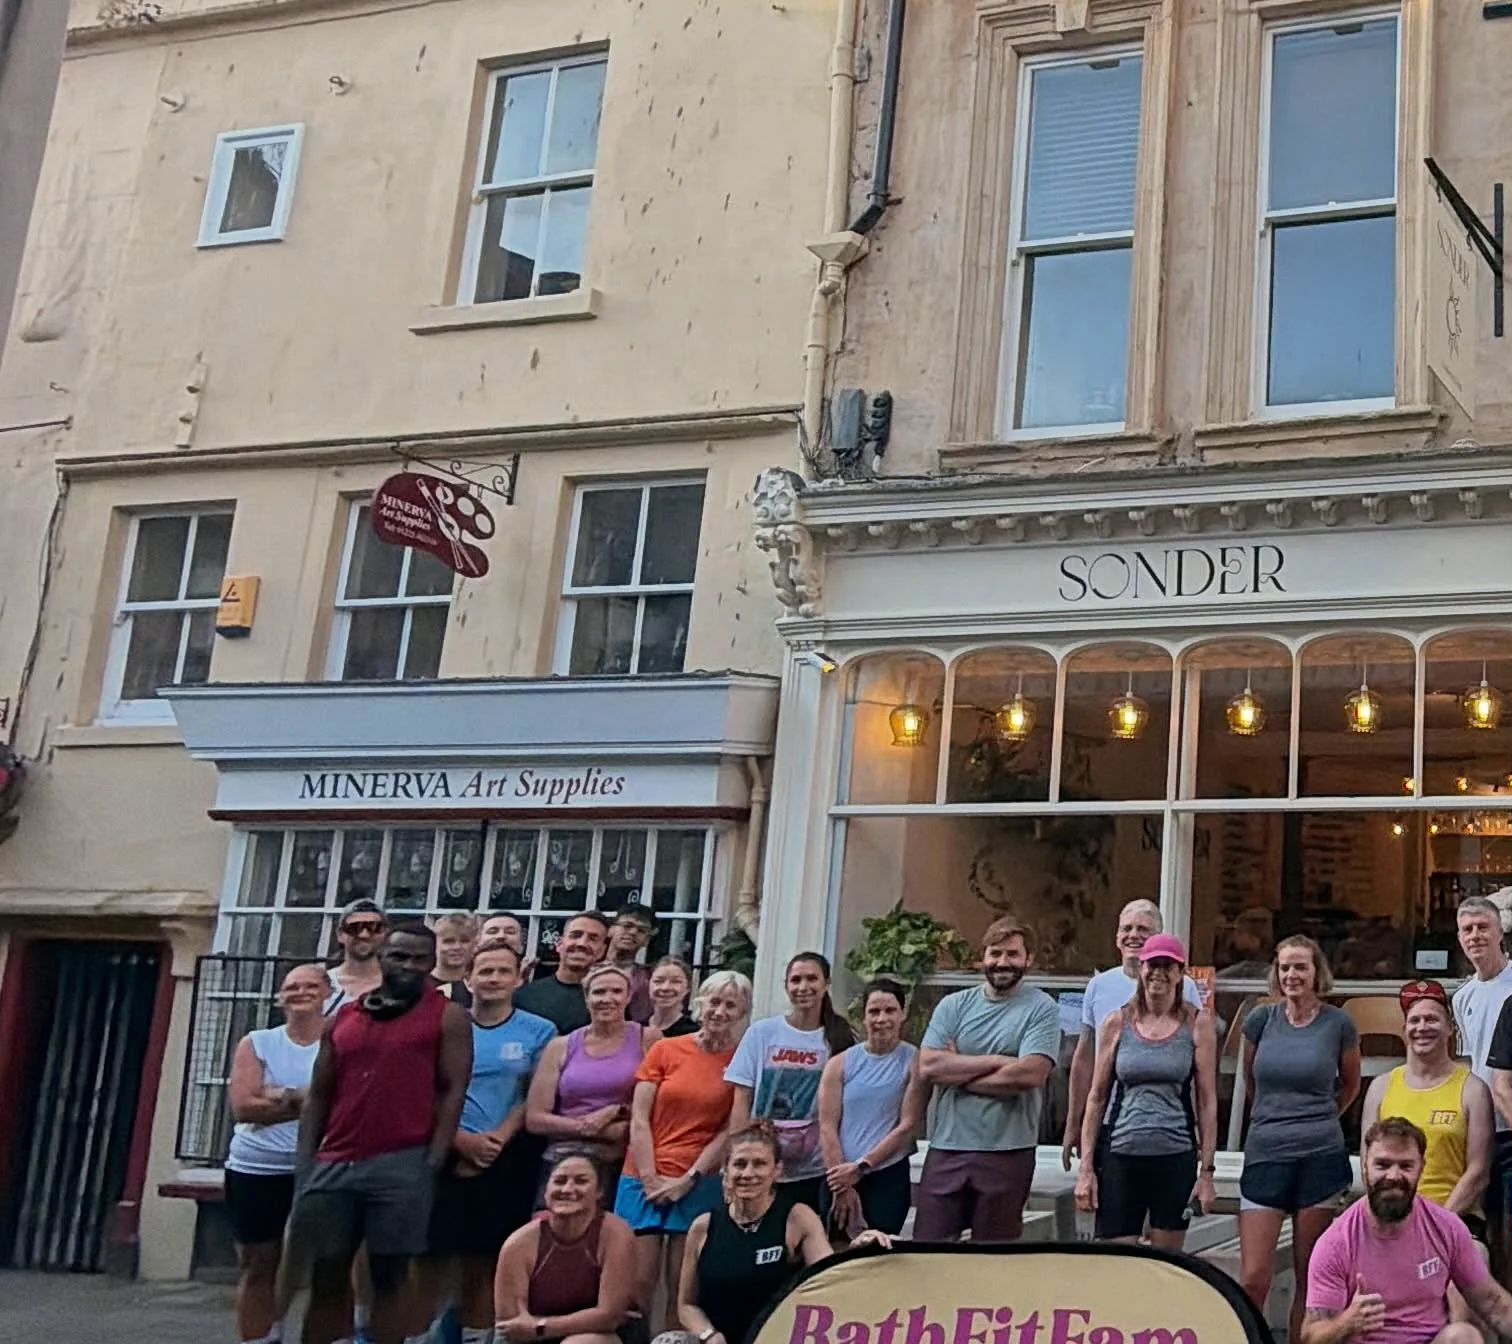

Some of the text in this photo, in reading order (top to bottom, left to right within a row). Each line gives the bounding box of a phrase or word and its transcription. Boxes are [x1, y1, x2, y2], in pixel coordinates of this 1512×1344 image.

[378, 506, 431, 532] Art Supplies
[380, 493, 433, 522] MINERVA
[1058, 544, 1287, 602] SONDER
[299, 768, 626, 804] MINERVA Art Supplies
[772, 1047, 818, 1065] JAWS
